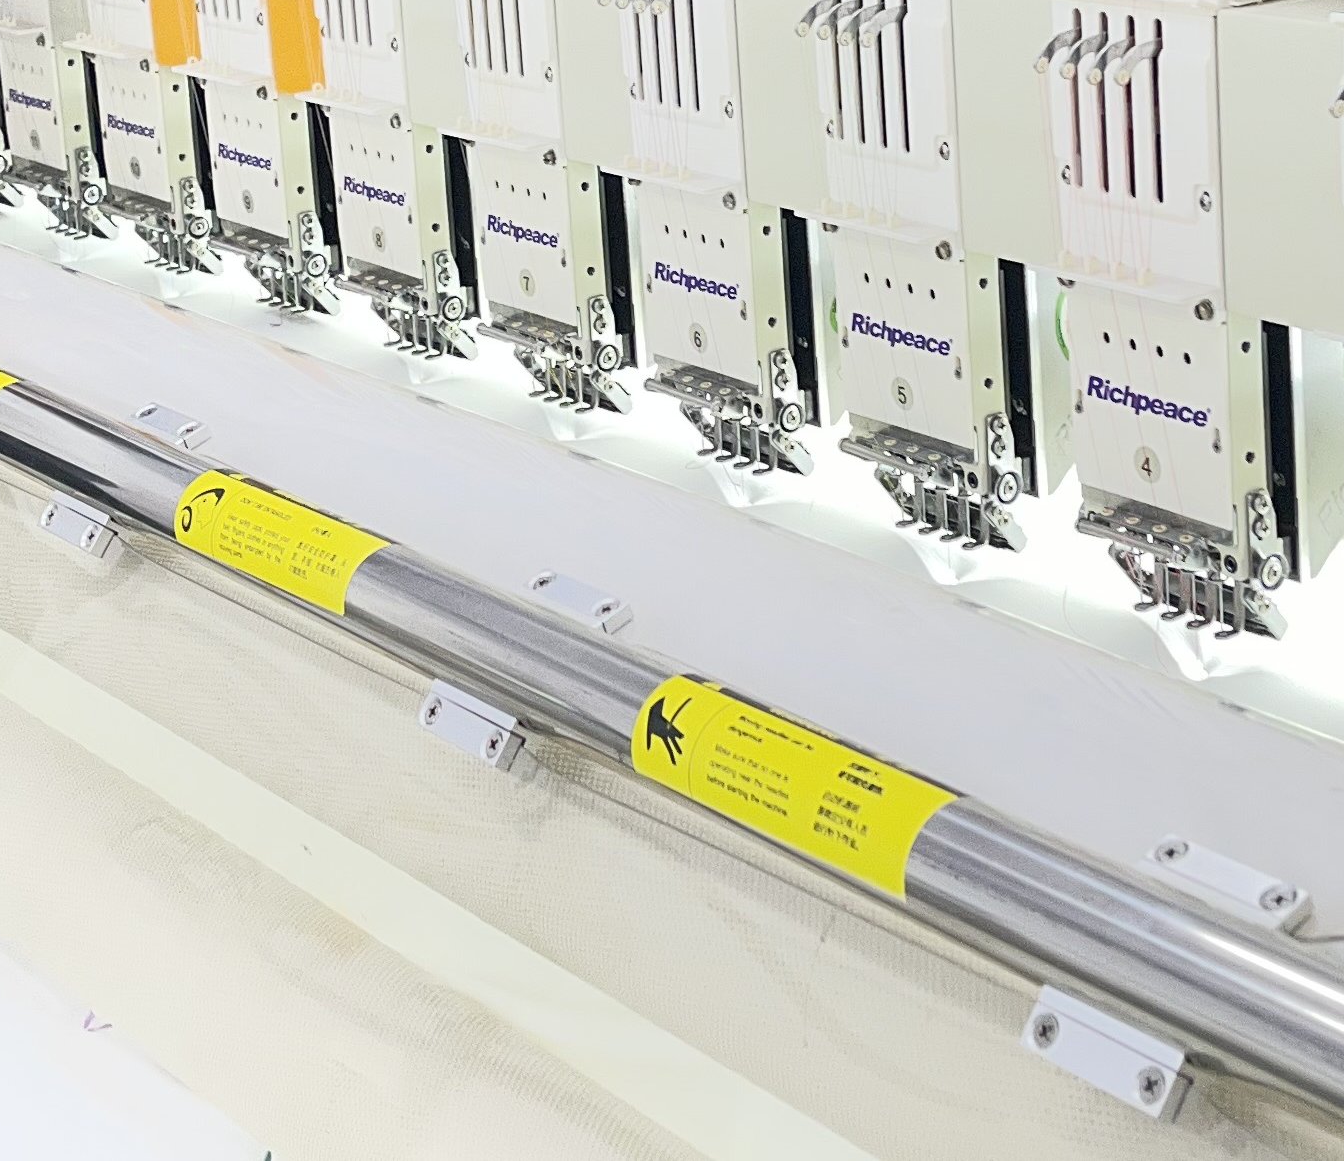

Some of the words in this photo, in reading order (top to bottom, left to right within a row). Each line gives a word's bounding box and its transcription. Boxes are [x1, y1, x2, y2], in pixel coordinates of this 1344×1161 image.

[107, 113, 155, 138] Richpeace
[218, 143, 272, 171] Richpeace
[344, 176, 405, 206] Richpeace
[487, 214, 557, 248] Richpeace
[522, 275, 531, 291] 7
[655, 261, 738, 300] Richpeace
[693, 330, 702, 348] 6
[851, 313, 951, 356] Richpeace
[897, 386, 907, 405] 5
[1087, 375, 1208, 426] Richpeace
[1141, 457, 1152, 477] 4
